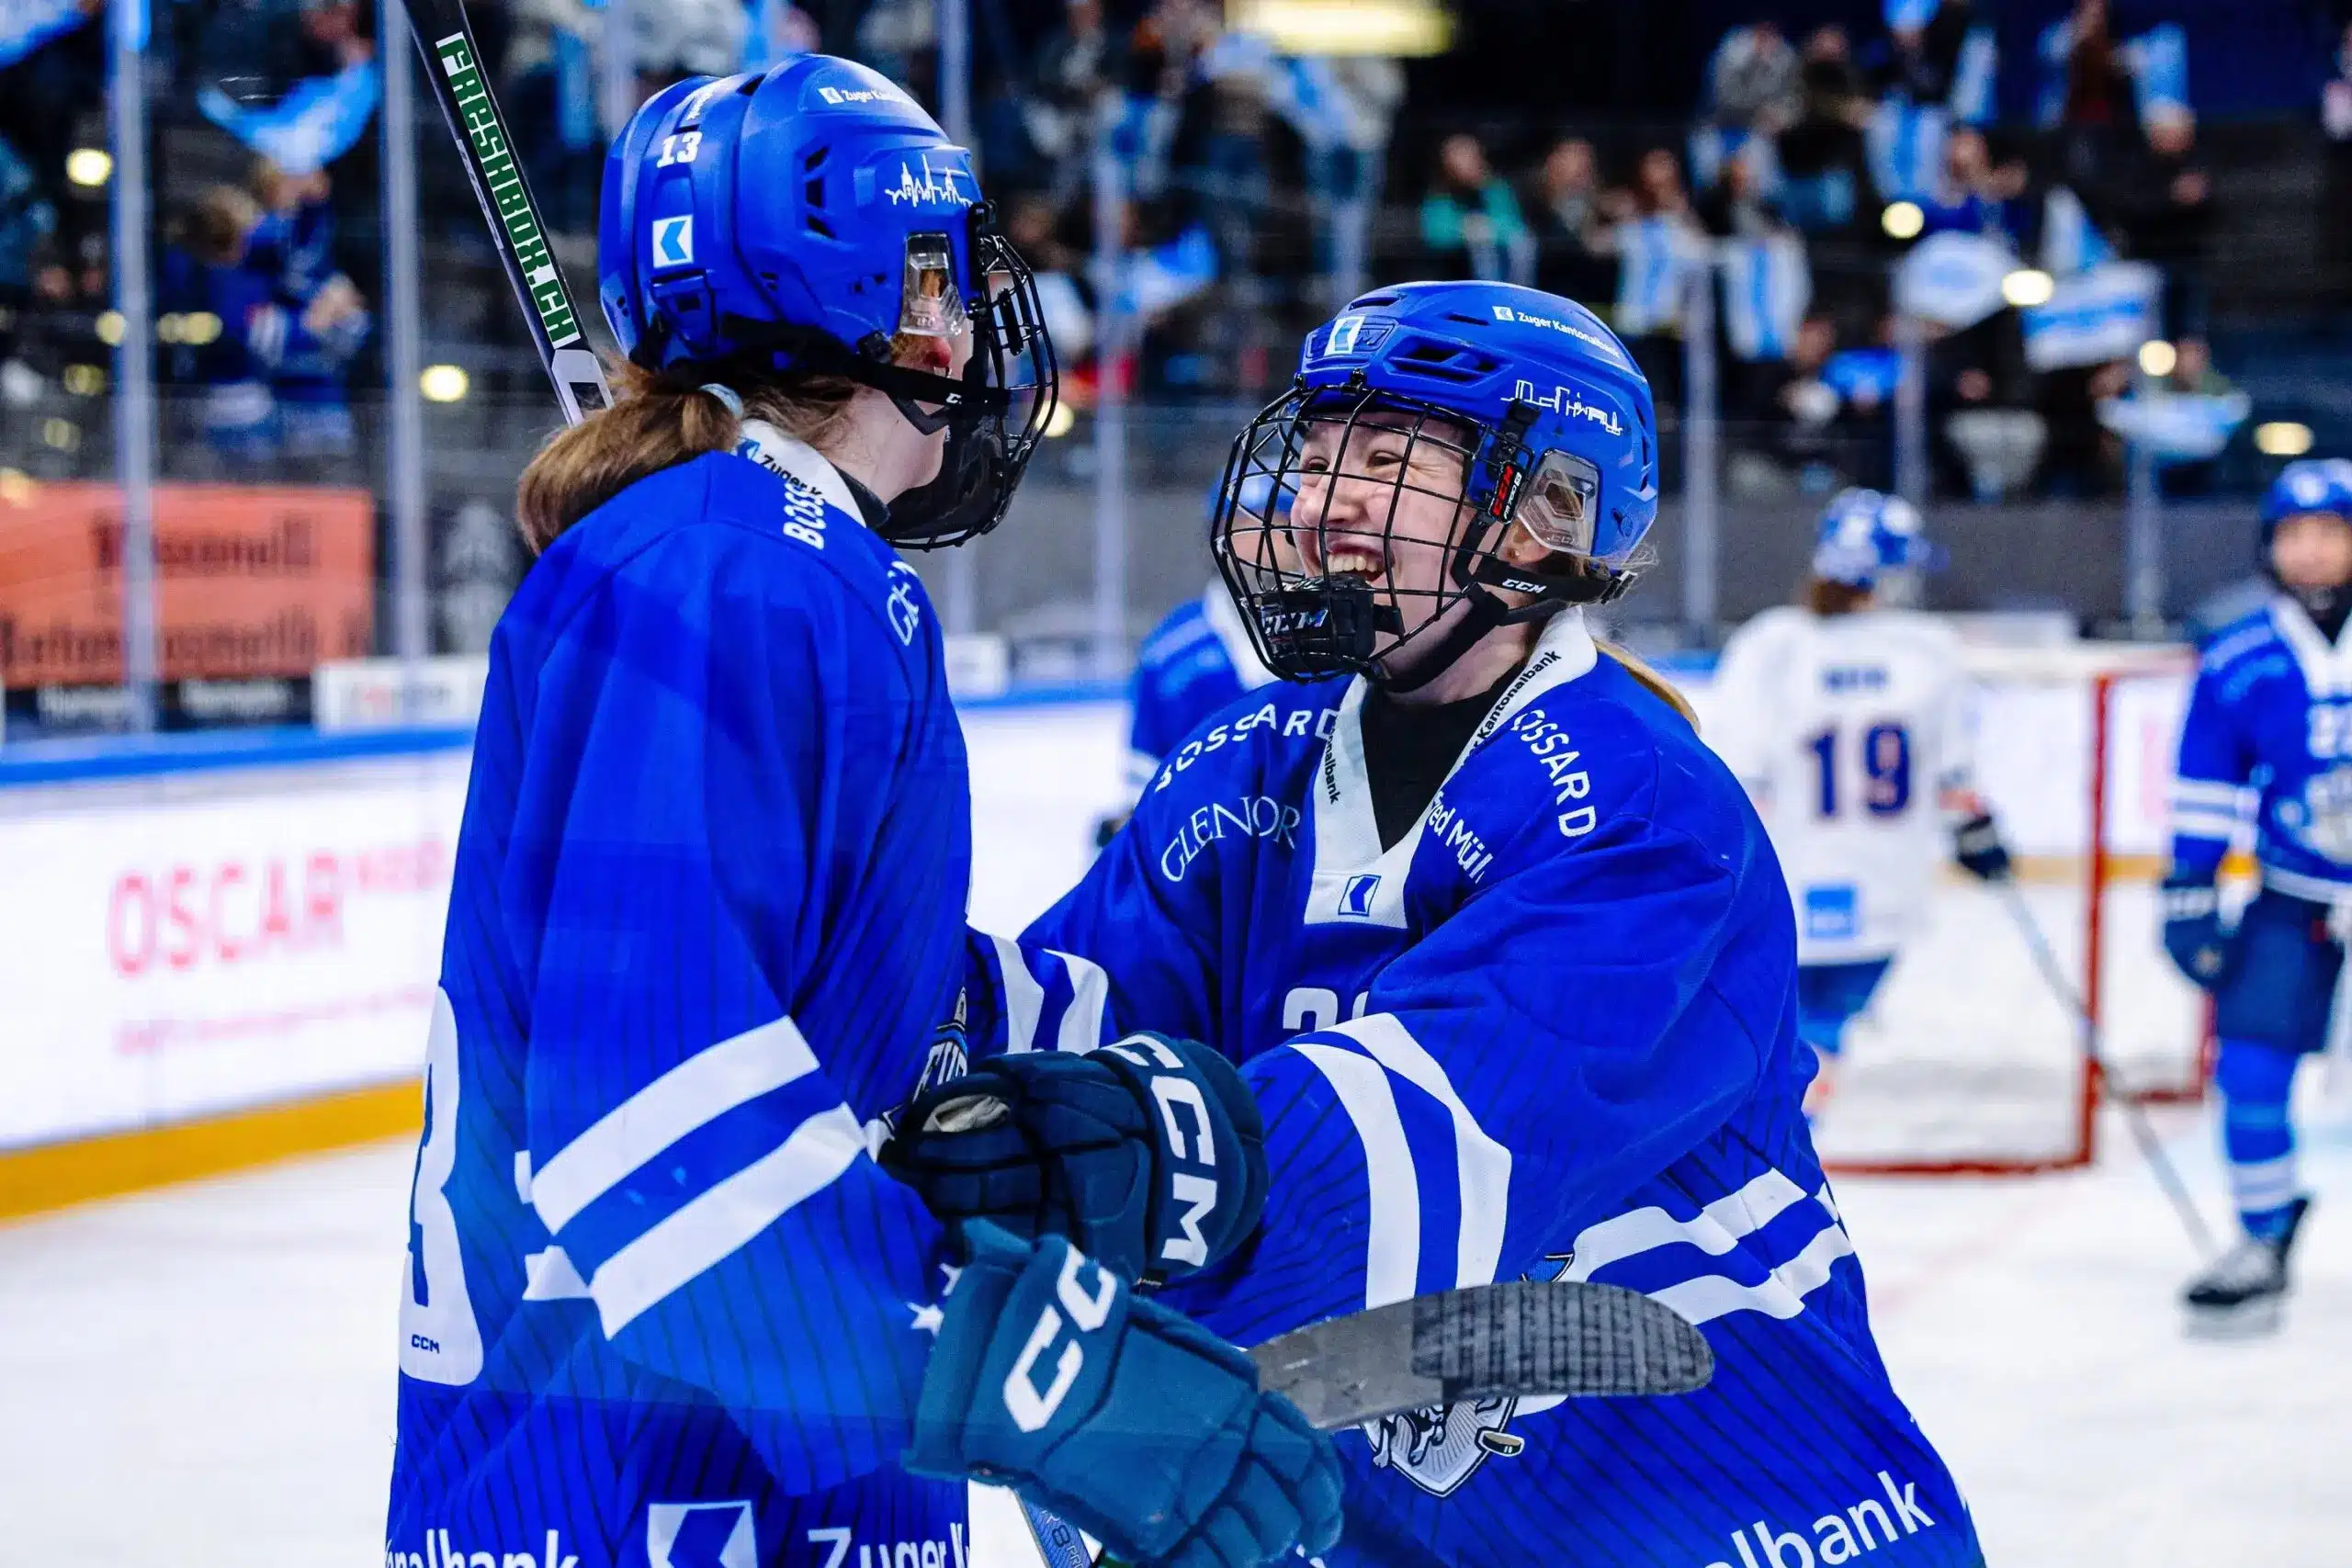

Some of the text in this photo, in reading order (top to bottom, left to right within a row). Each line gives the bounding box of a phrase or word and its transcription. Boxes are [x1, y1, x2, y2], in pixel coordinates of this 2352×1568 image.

[656, 130, 703, 168] 13
[1517, 311, 1621, 358] Zuger Kantonalbank
[1501, 578, 1547, 593] CCM
[1476, 649, 1562, 739] Kantonalbank
[1806, 723, 1911, 817] 19
[108, 851, 344, 976] OSCAR
[1100, 1035, 1217, 1267] CCM
[411, 1334, 440, 1354] CCM
[1705, 1471, 1936, 1568] lbank
